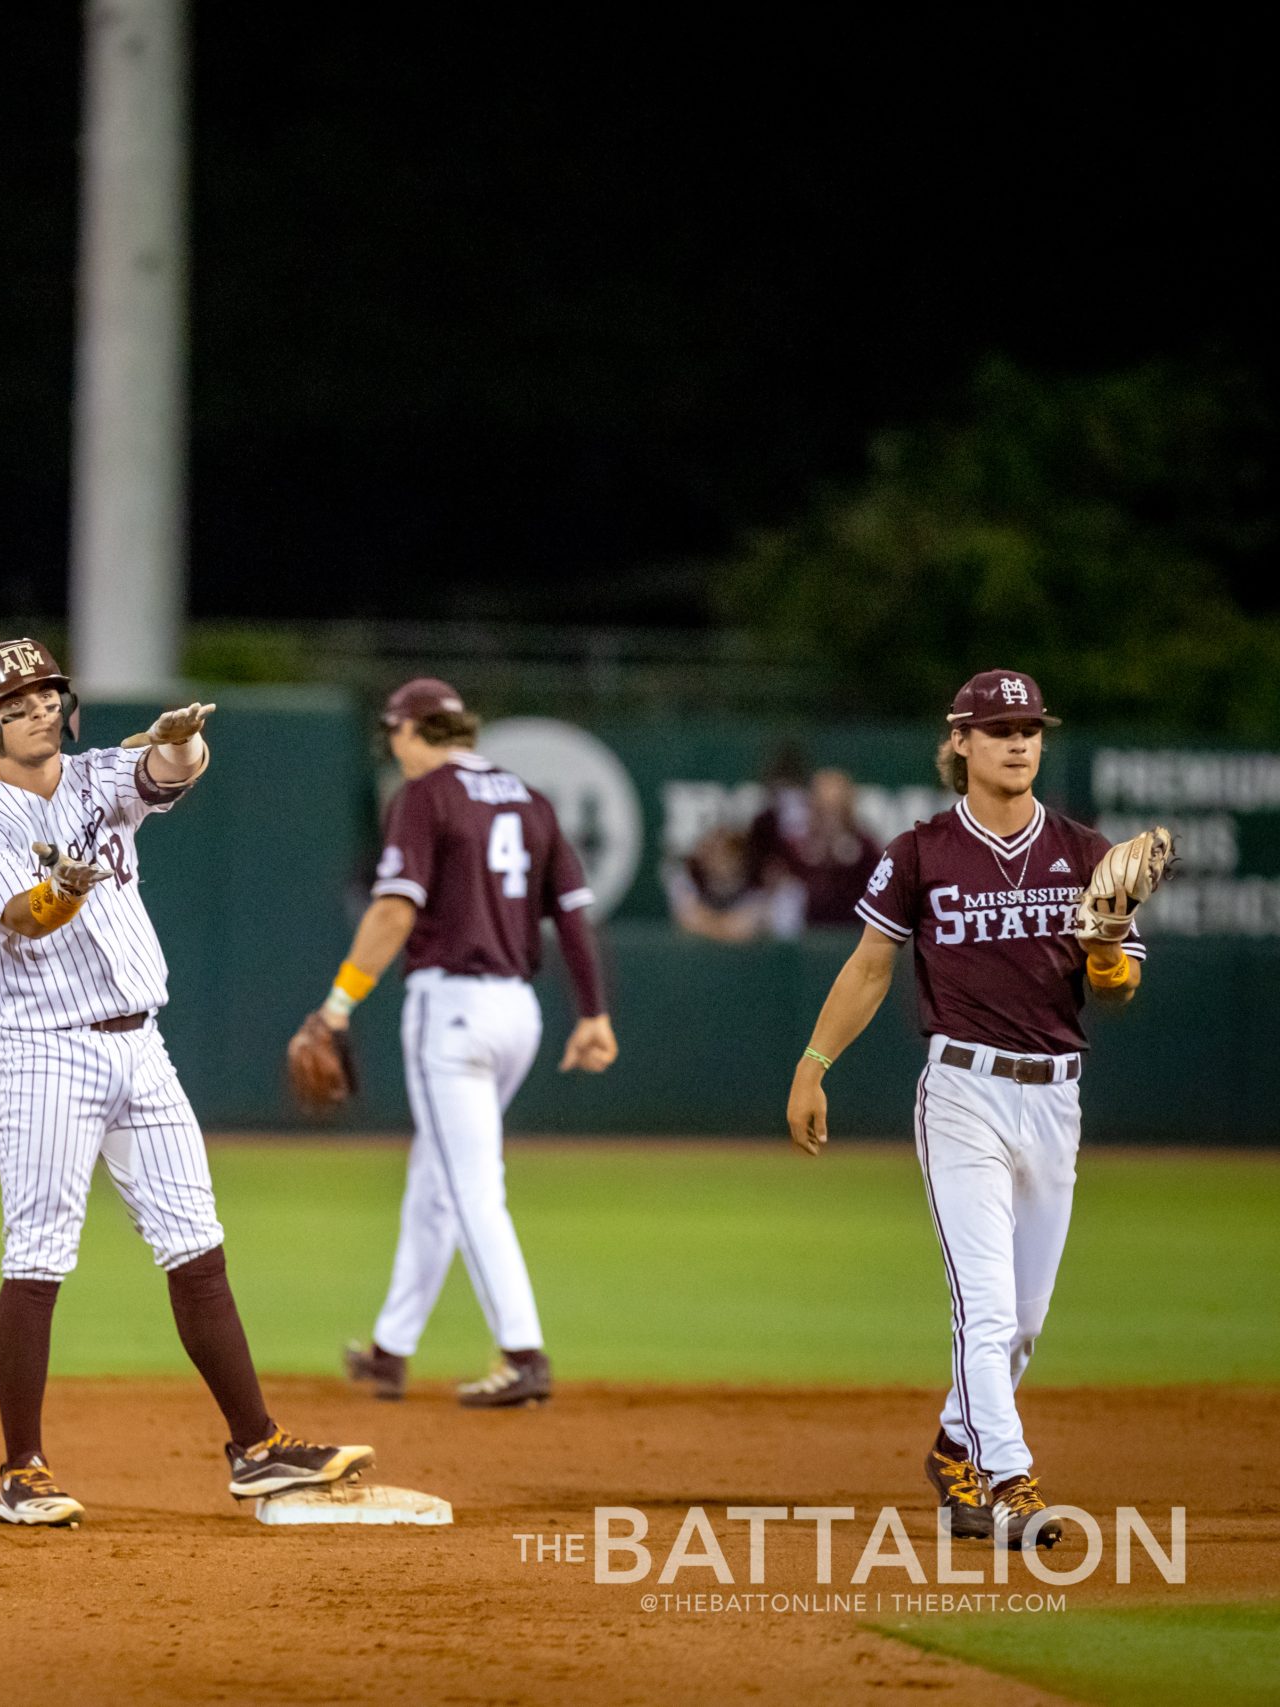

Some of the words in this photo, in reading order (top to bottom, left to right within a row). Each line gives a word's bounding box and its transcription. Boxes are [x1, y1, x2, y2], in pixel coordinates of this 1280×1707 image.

[99, 834, 133, 892] 12
[488, 813, 531, 899] 4
[930, 884, 1080, 945] STATE
